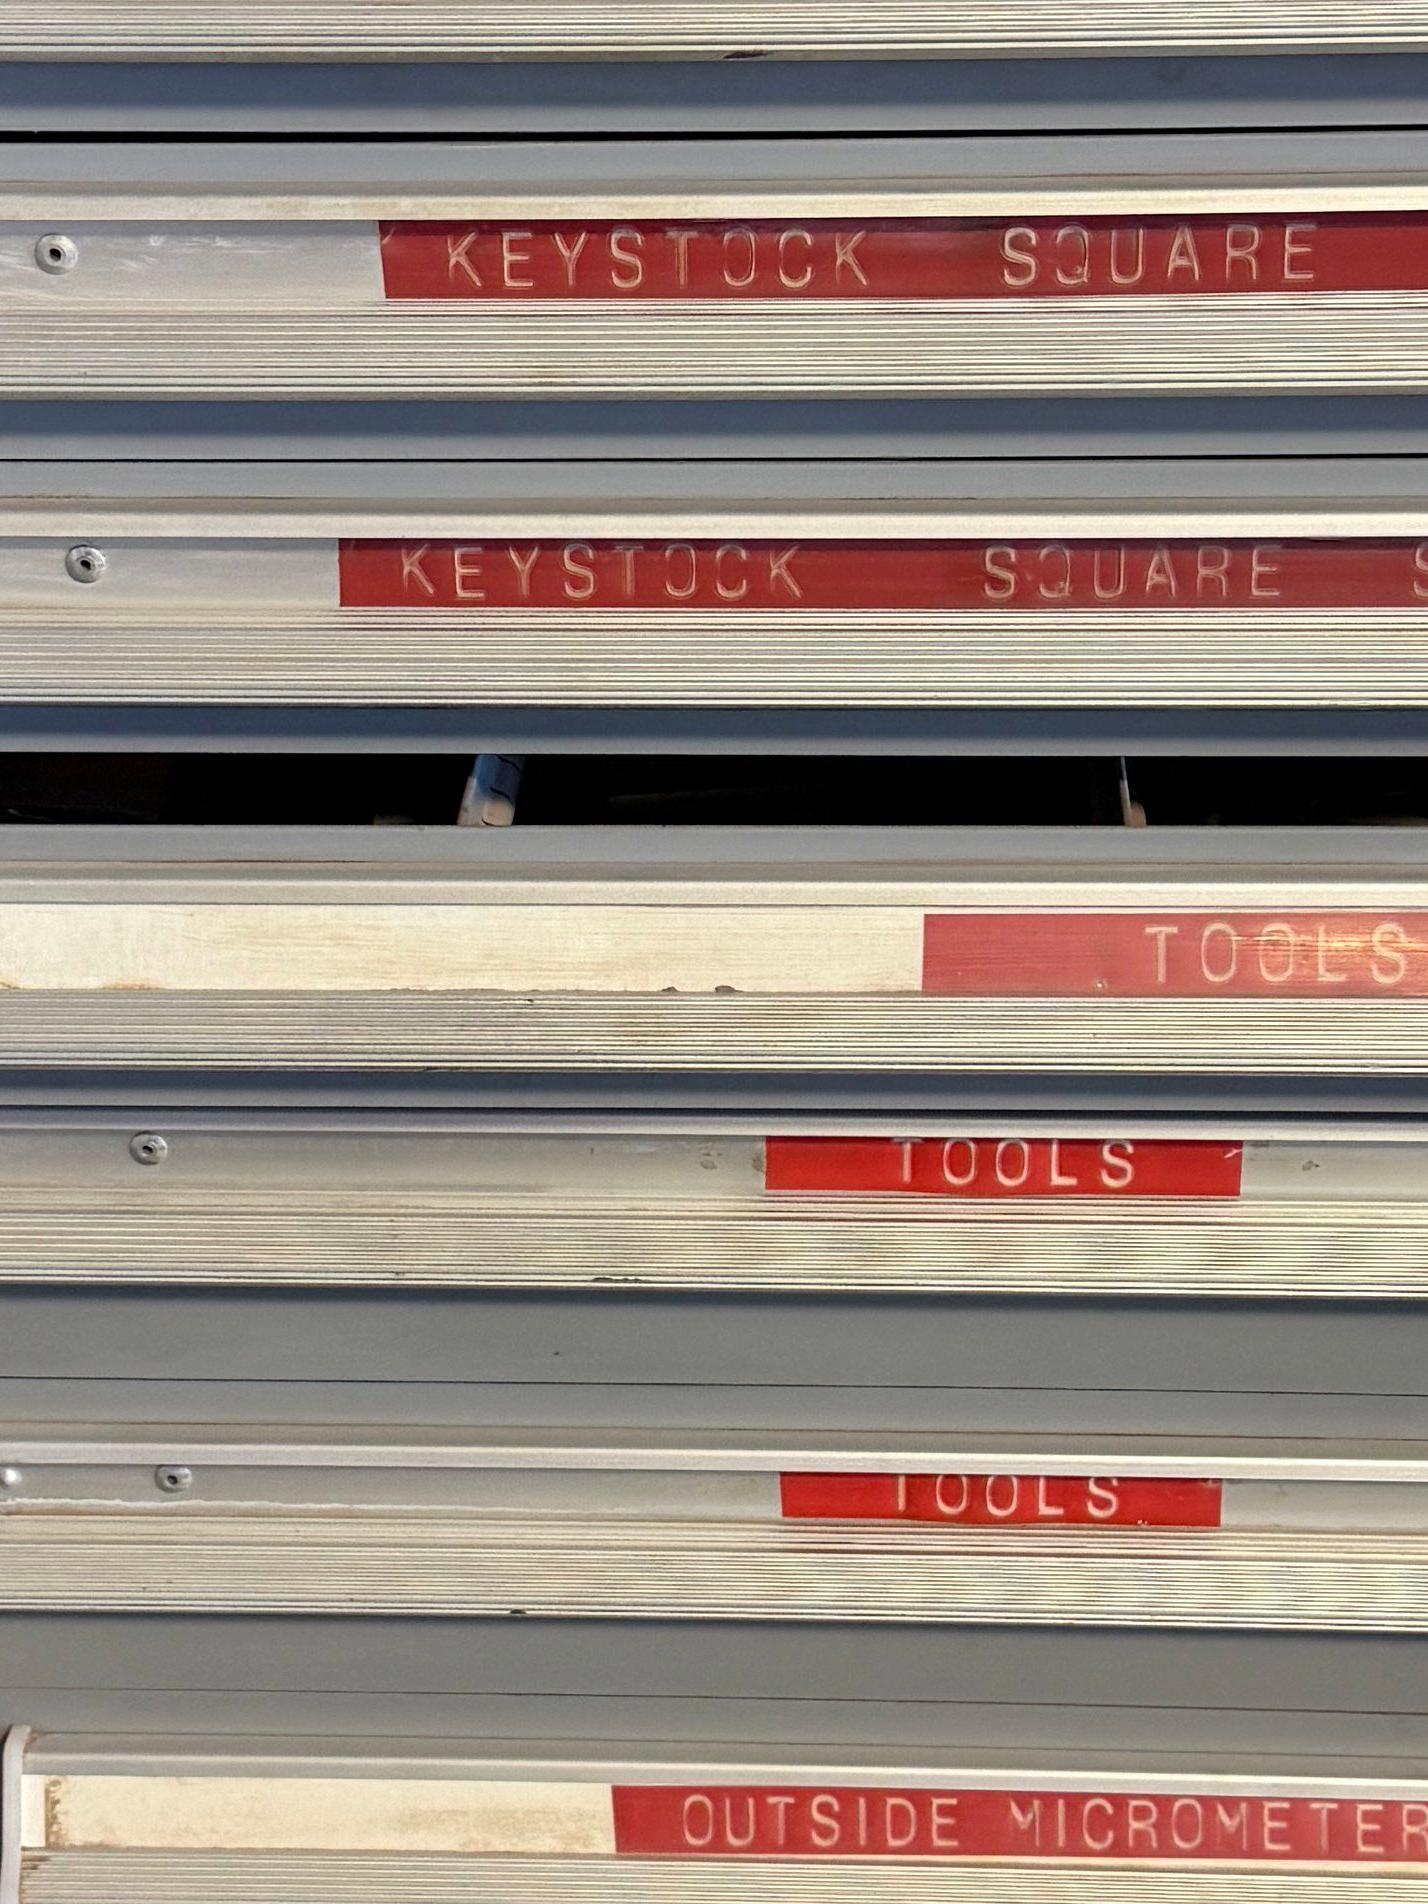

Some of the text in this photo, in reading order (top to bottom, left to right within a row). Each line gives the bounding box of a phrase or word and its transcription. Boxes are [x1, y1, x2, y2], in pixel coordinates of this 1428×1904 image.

[447, 226, 870, 288] KEYSTOCK
[1000, 220, 1317, 287] SQUARE
[400, 542, 805, 602] KEYSTOCK
[982, 541, 1282, 602] SQUARE
[1144, 920, 1409, 985] TOOLS
[892, 1137, 1136, 1188] TOOLS
[681, 1793, 962, 1848] OUTSIDE
